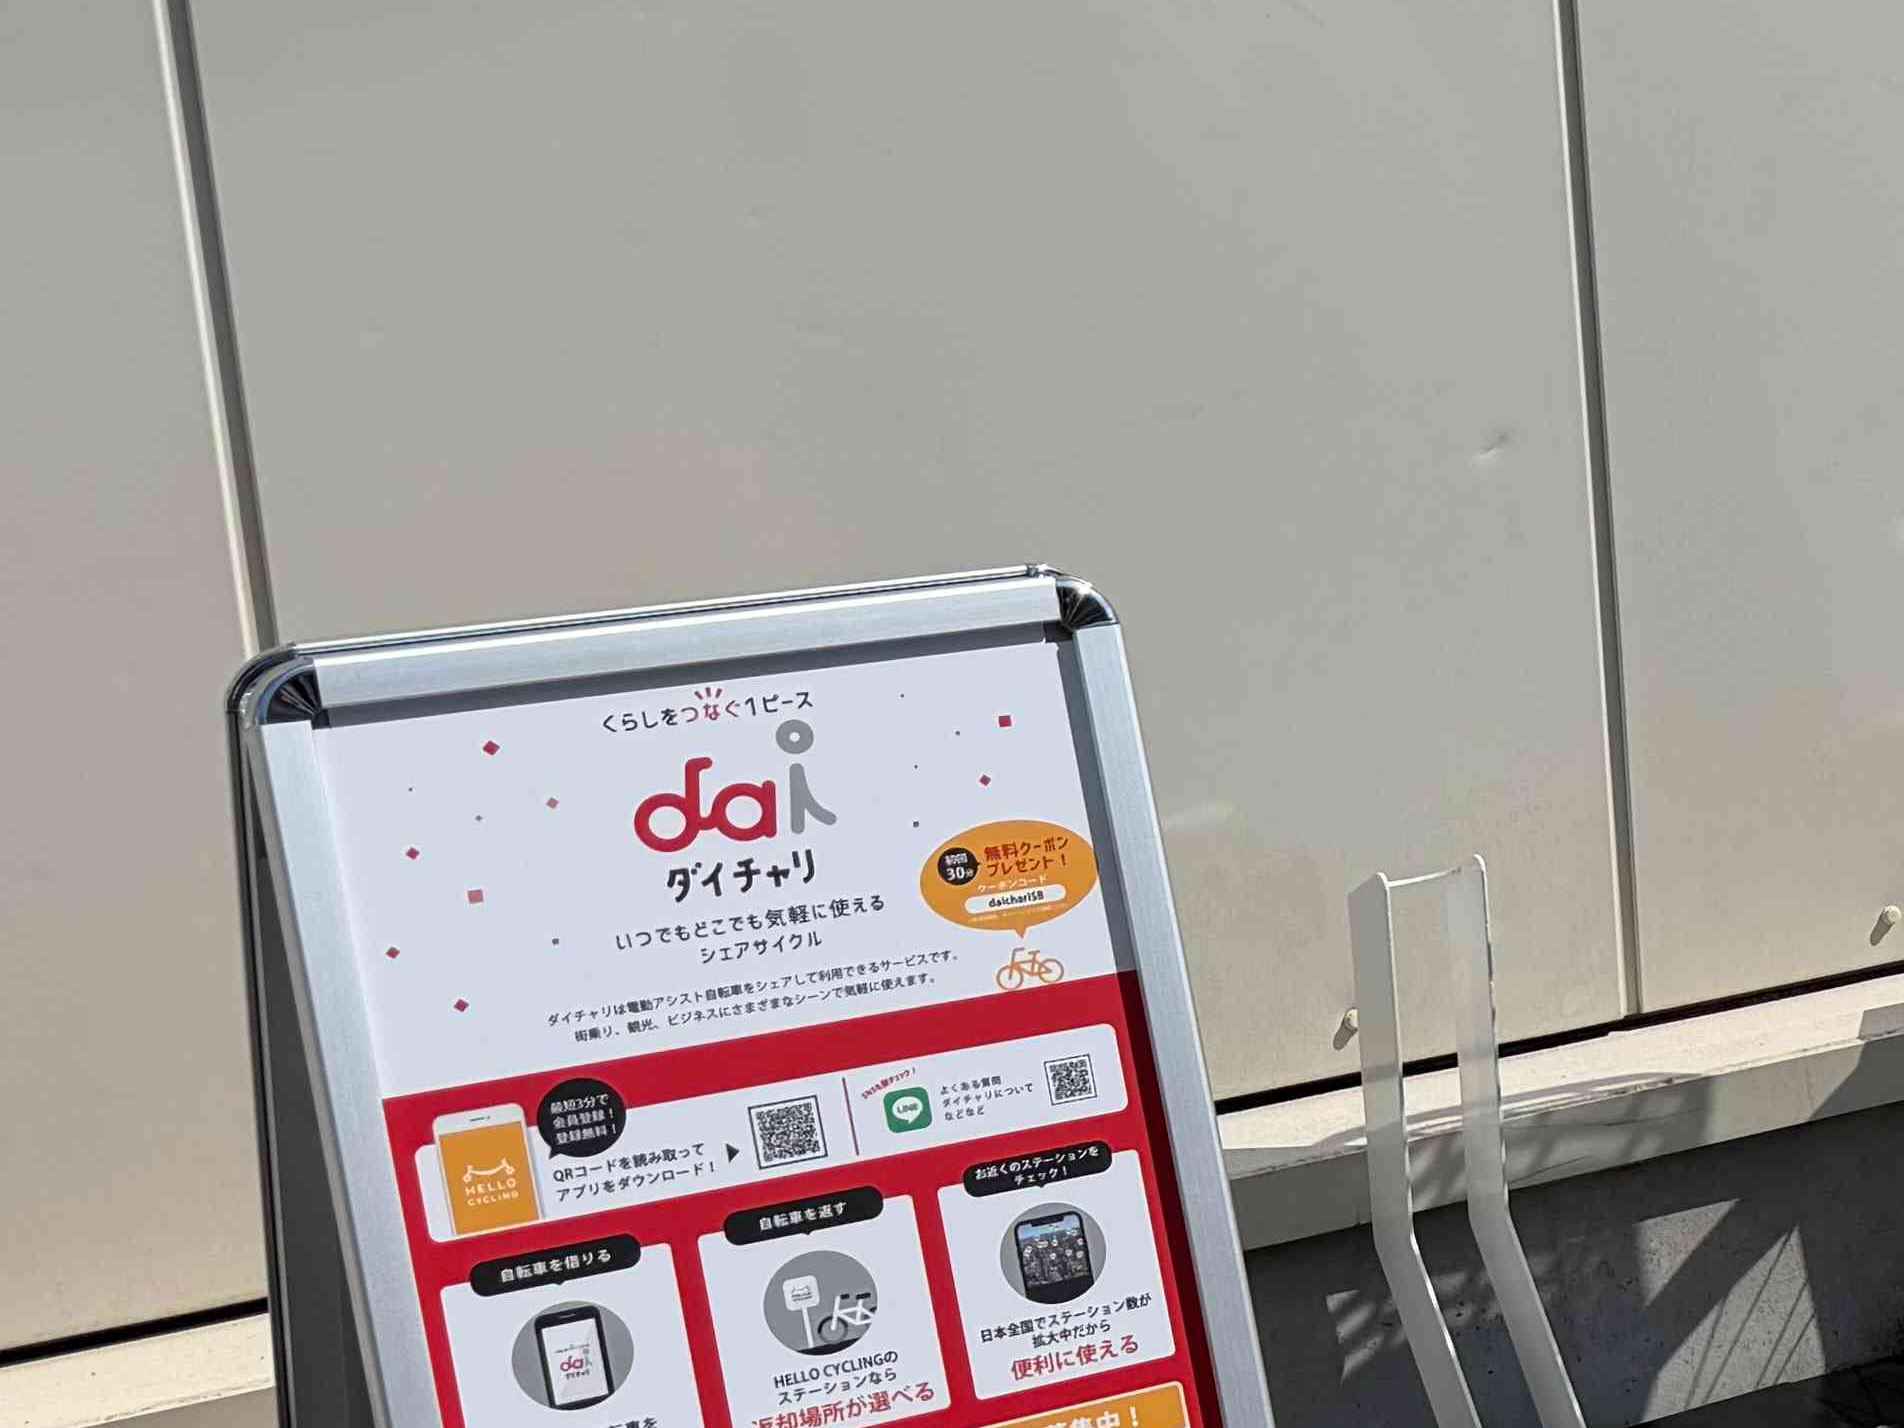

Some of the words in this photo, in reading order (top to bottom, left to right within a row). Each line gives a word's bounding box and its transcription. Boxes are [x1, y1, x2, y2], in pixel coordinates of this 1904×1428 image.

[634, 719, 837, 852] dai
[984, 836, 1069, 862] 無料クーポン
[667, 849, 816, 903] ダイチャリ
[615, 895, 885, 950] いつでもどこでも気軽に使える
[700, 931, 822, 964] シェアサイクル
[897, 1103, 919, 1114] LINE
[943, 1083, 1034, 1108] ダイチャリについて
[552, 1142, 705, 1182] QRコードを読み取って
[975, 1145, 1099, 1180] お近くのステーションを
[464, 1177, 517, 1196] HELLO
[466, 1190, 519, 1207] CYCLING
[759, 1201, 847, 1231] 自転車を返す
[500, 1249, 612, 1283] 自転車を借りる
[980, 1292, 1152, 1343] 日本全国でステーション数が
[1032, 1319, 1111, 1349] 拡大中だから
[774, 1367, 820, 1389] HELLO
[823, 1350, 898, 1378] CYCLINGの
[1011, 1334, 1139, 1381] 便利に使える
[777, 1368, 897, 1406] ステーションなら
